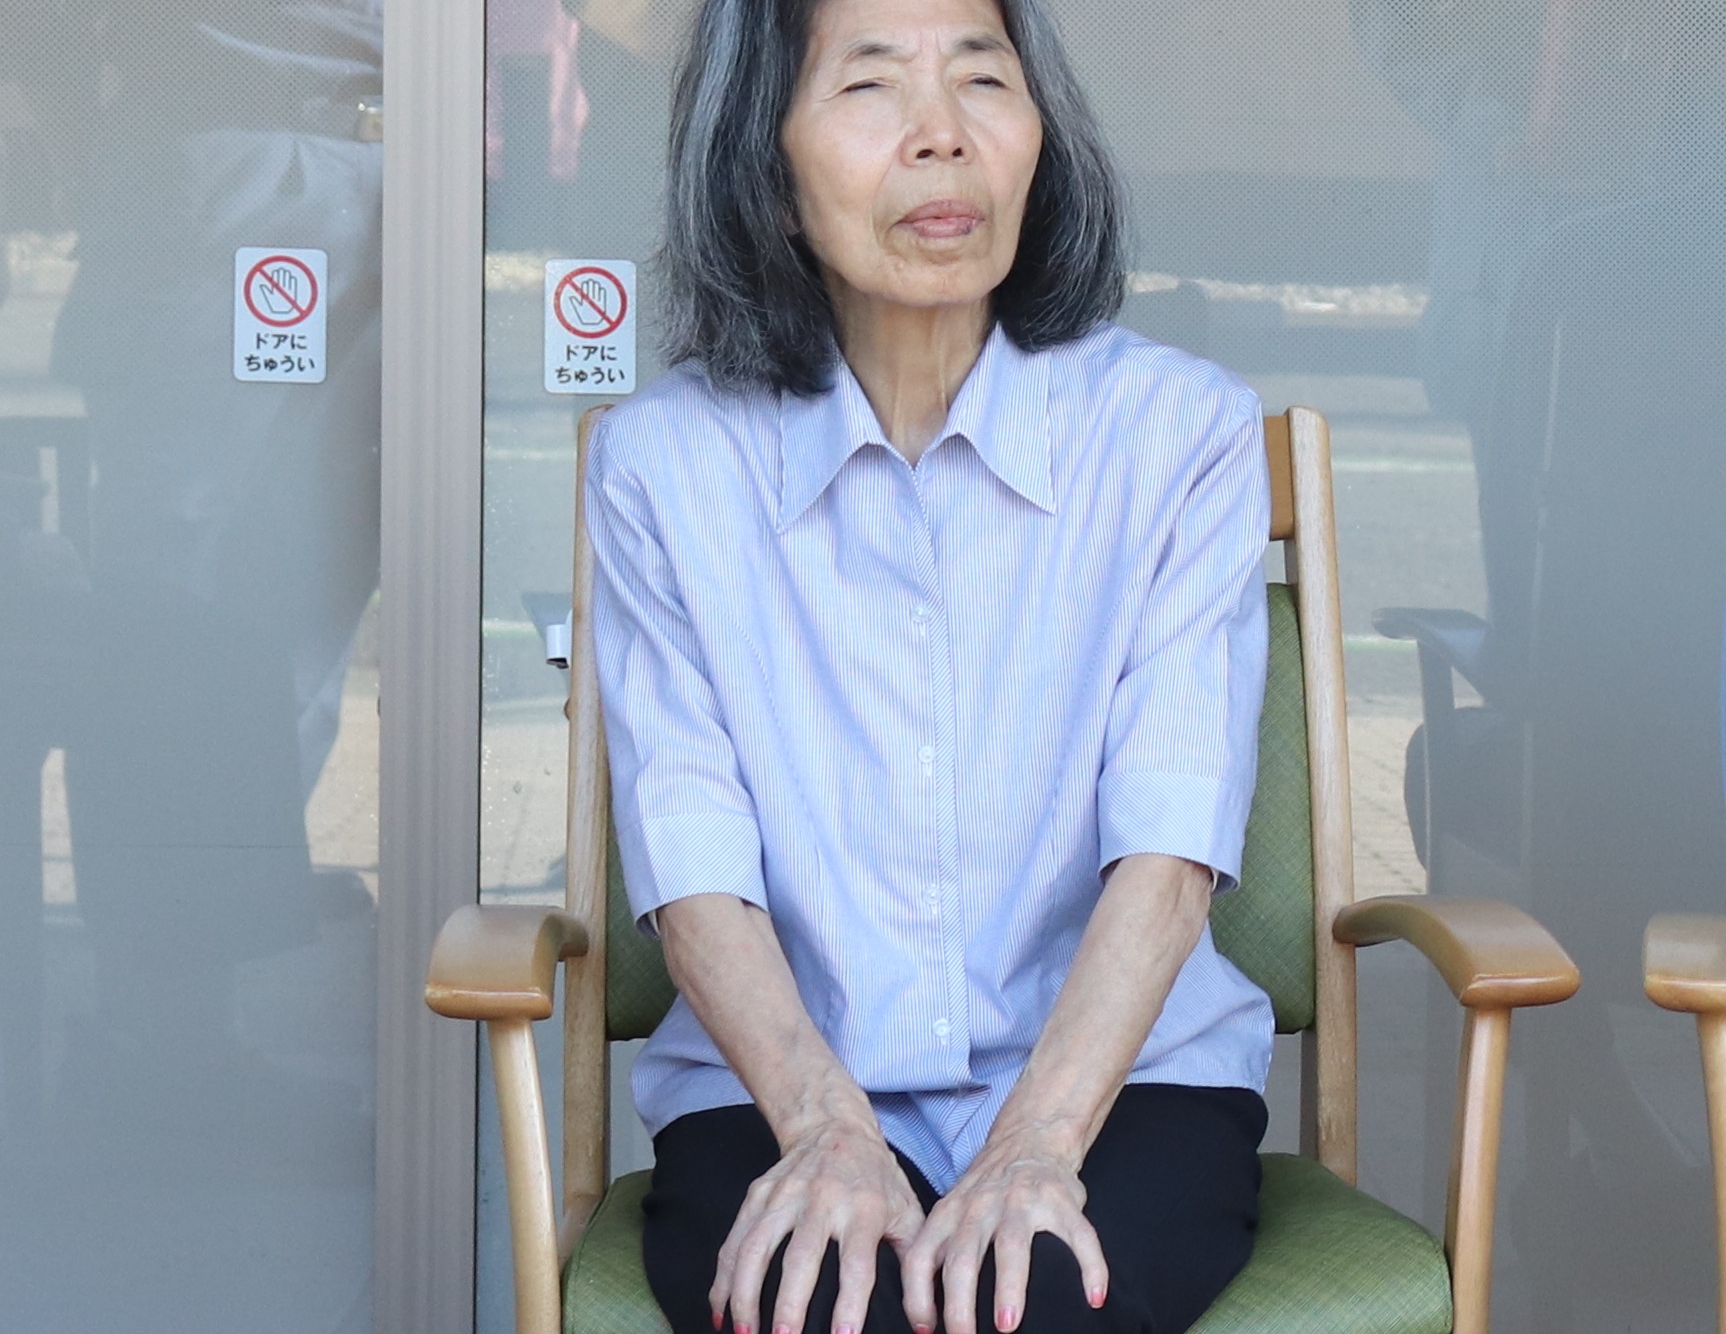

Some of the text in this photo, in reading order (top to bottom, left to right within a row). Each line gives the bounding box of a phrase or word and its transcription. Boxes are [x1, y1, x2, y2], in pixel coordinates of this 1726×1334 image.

[256, 332, 308, 350] ドアに
[566, 345, 618, 362] ドアに
[244, 354, 315, 373] ちゅうい
[555, 366, 625, 385] ちゅうい
